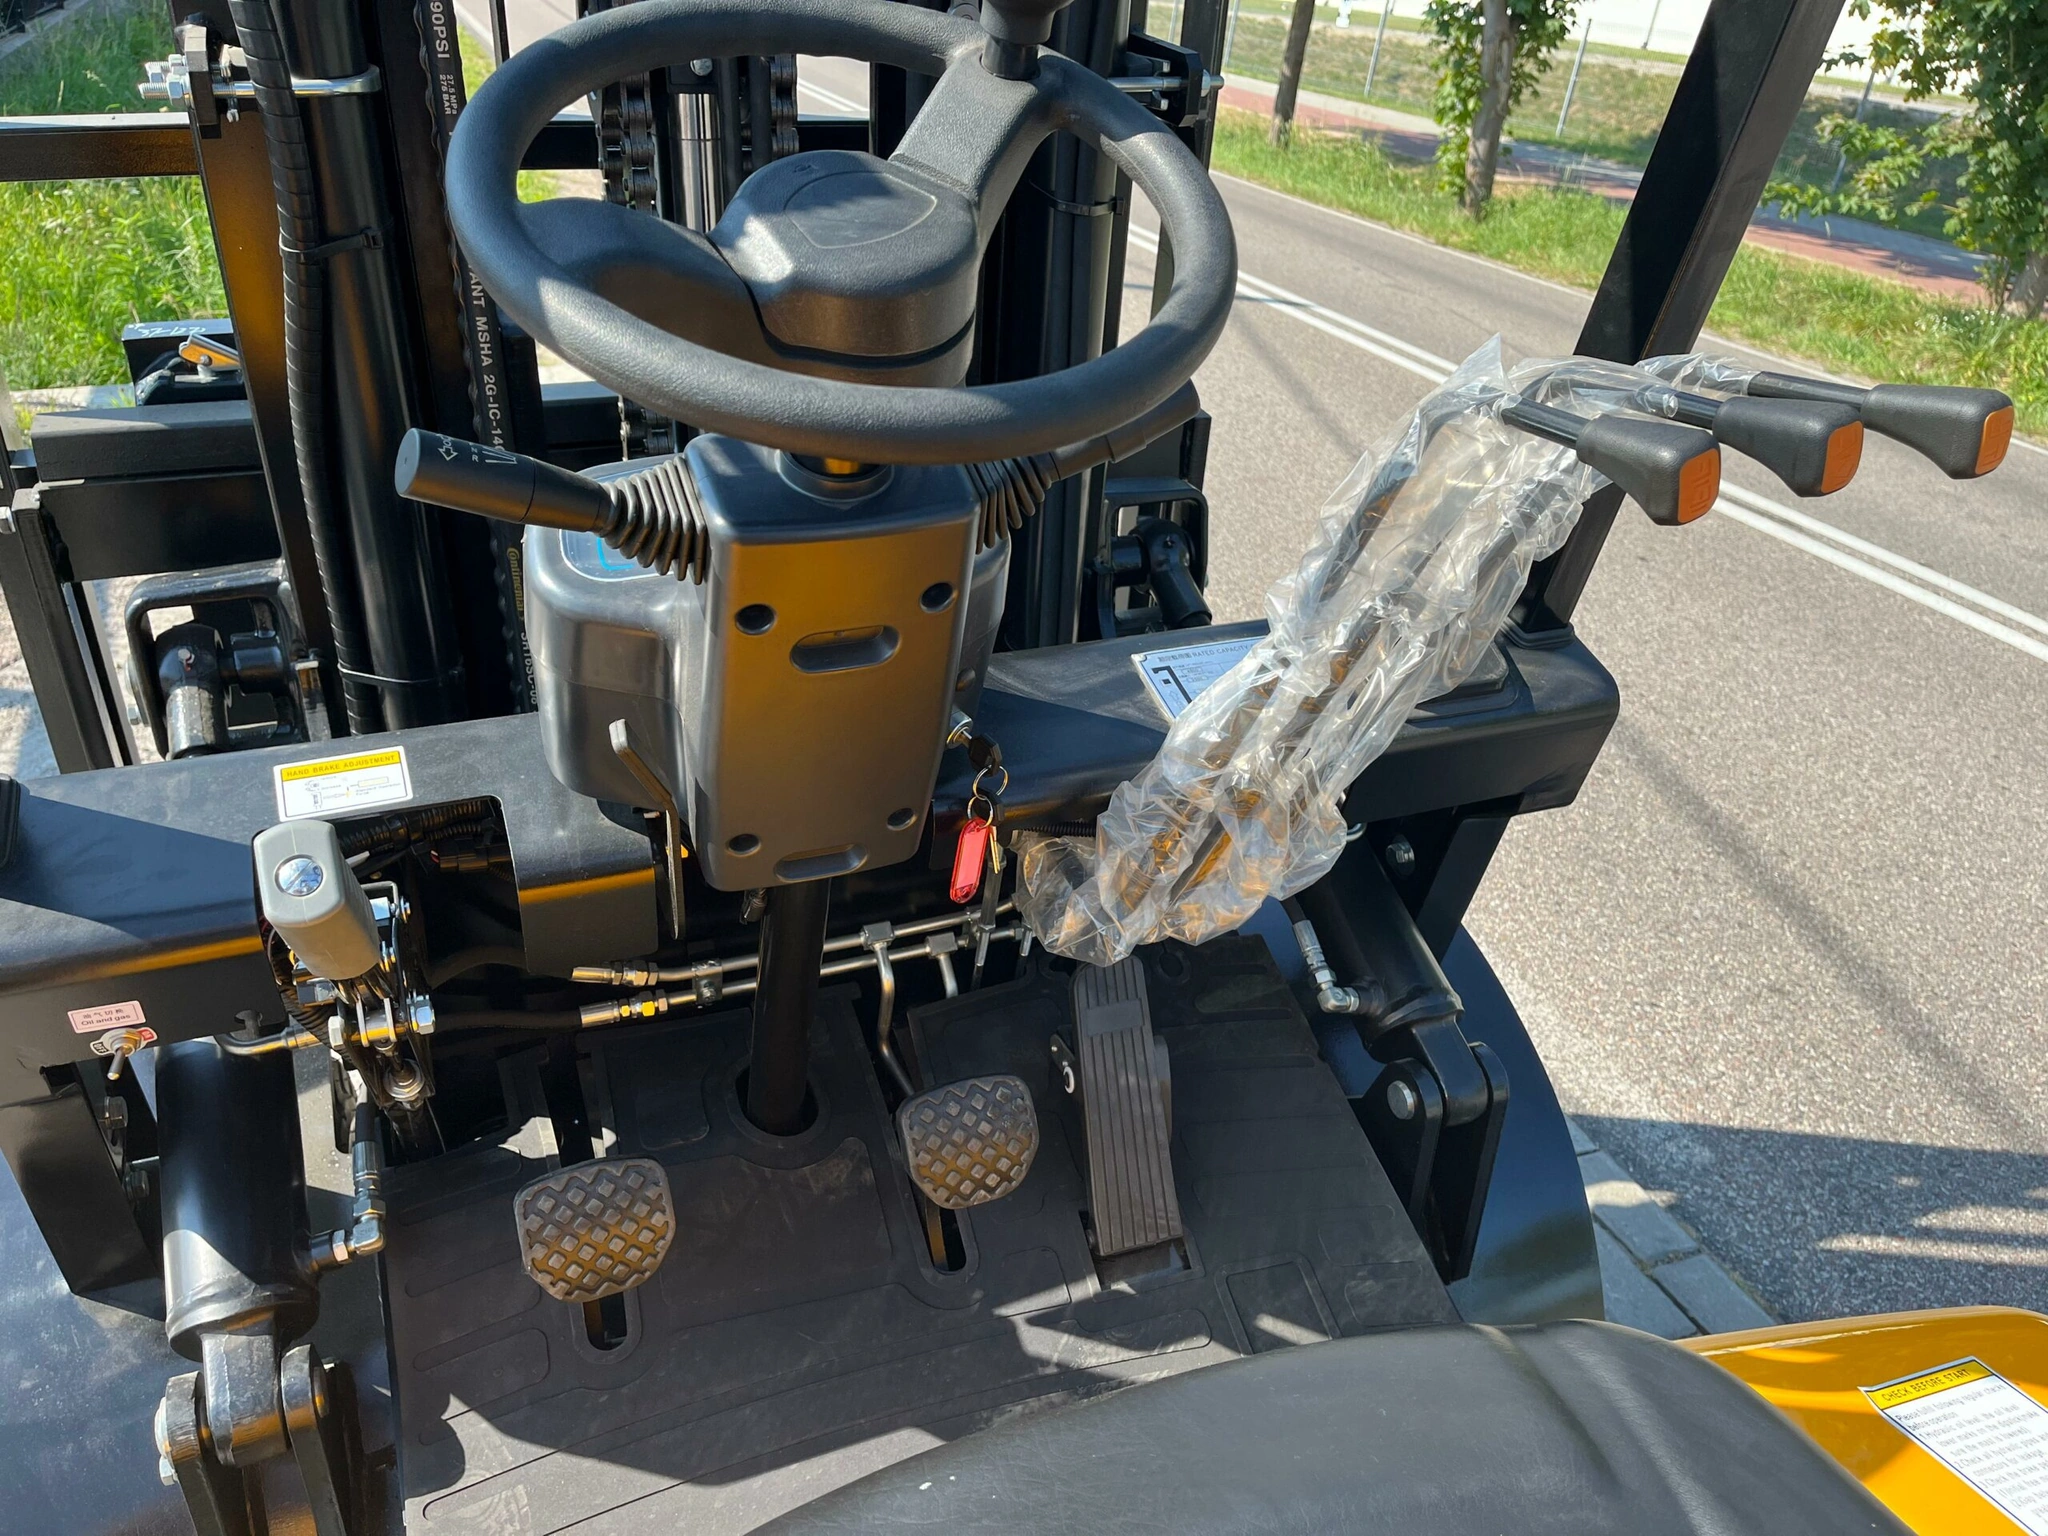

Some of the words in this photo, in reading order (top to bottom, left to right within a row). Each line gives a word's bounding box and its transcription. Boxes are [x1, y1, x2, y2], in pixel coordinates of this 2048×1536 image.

[475, 316, 493, 367] MSHA
[286, 768, 310, 778] HAND
[312, 763, 340, 774] BRAKE
[343, 755, 395, 768] ADJUSTMENT
[96, 1016, 113, 1024] and
[114, 1014, 131, 1022] gas
[1881, 1386, 1913, 1401] CHECK
[1910, 1376, 1946, 1393] BEFORE
[1943, 1368, 1971, 1382] START
